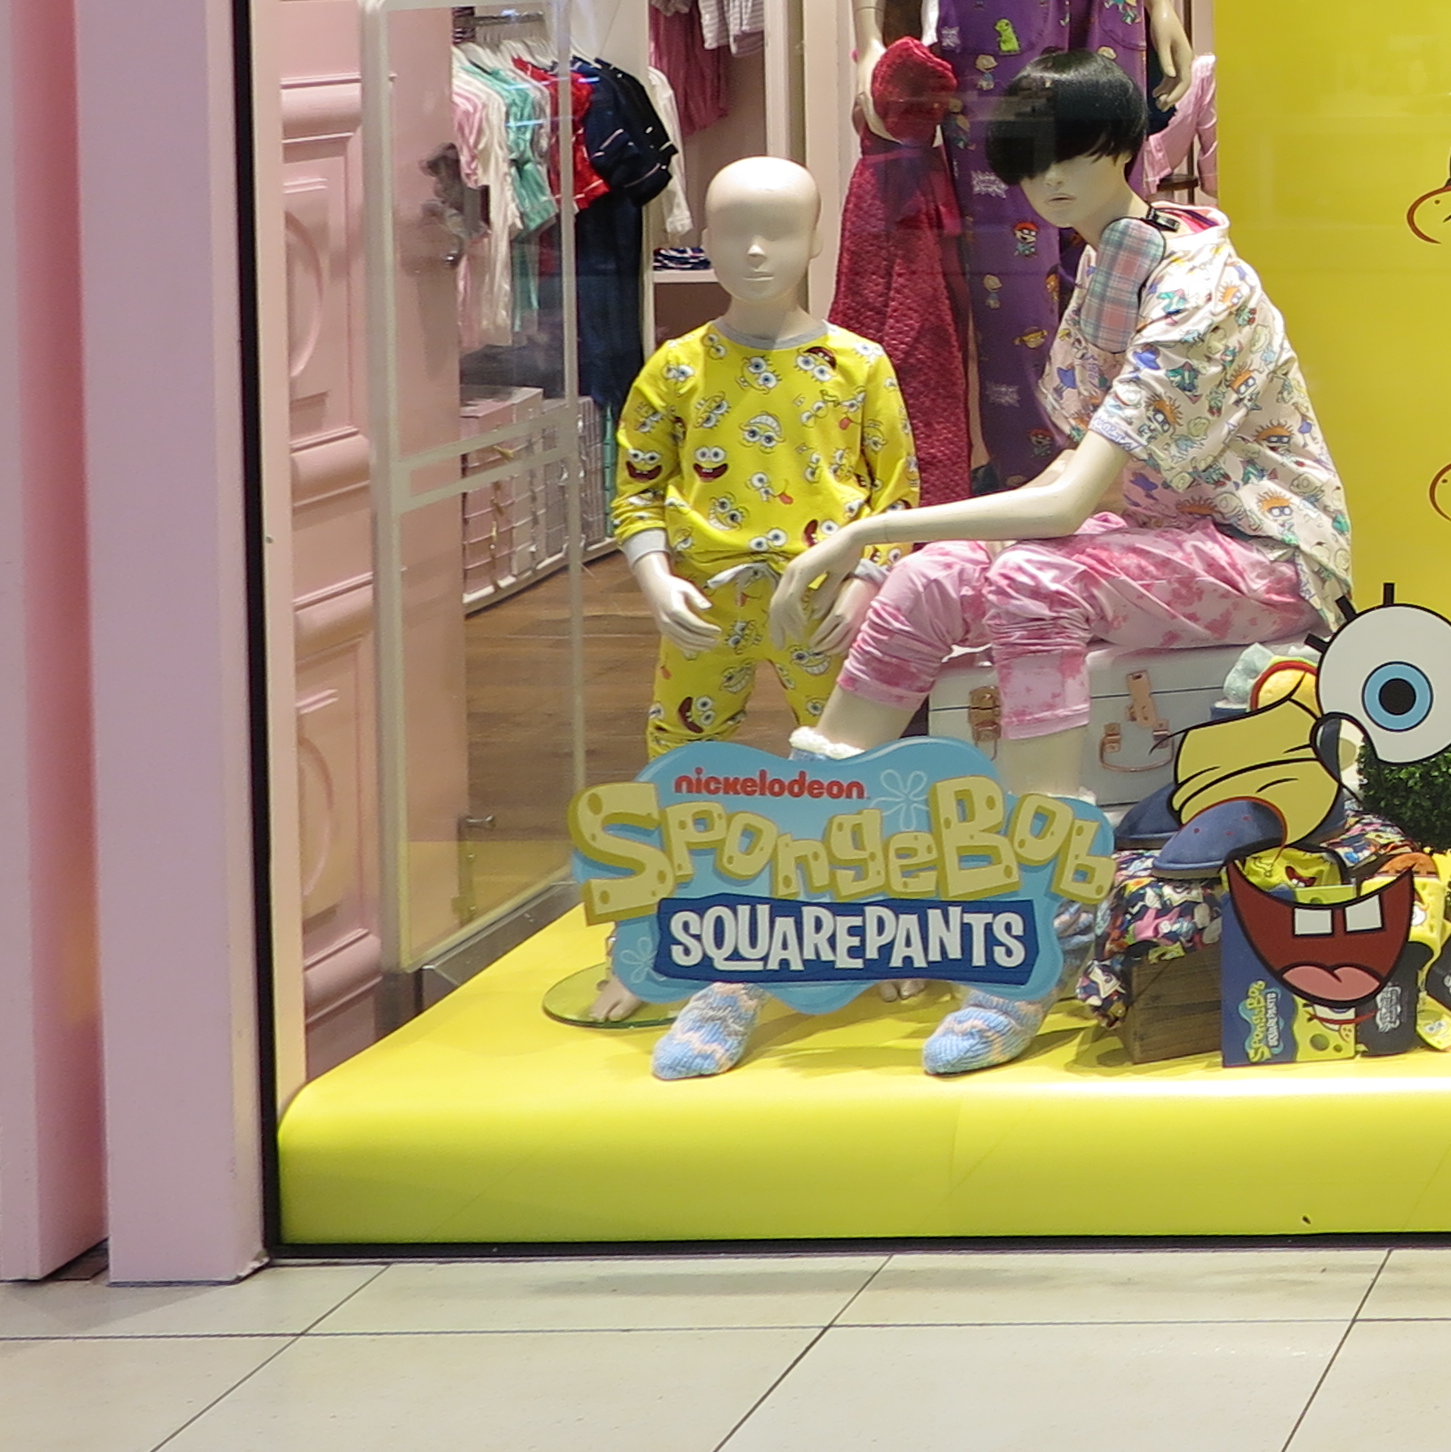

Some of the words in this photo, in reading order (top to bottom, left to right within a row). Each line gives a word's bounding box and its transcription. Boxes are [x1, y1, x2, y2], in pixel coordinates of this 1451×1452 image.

[673, 767, 866, 801] nickelodeon
[566, 774, 1117, 926] SpongeBob
[669, 902, 1027, 972] SQUAREPANTS
